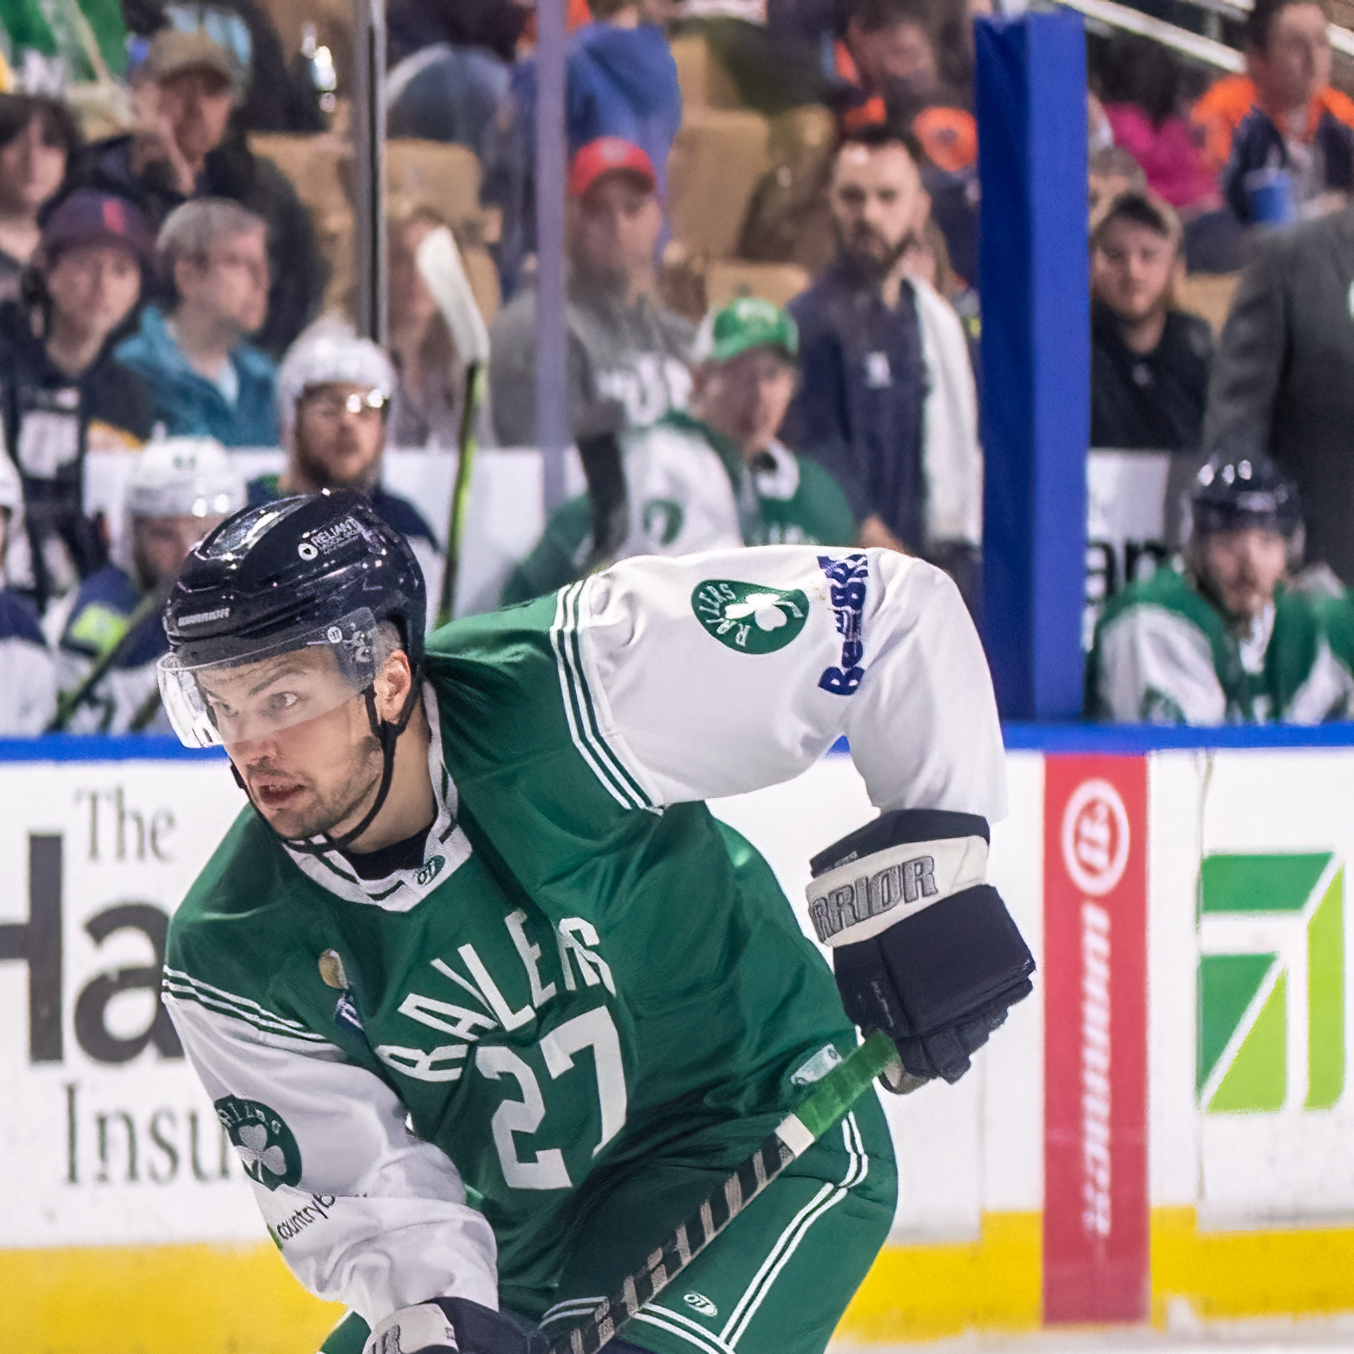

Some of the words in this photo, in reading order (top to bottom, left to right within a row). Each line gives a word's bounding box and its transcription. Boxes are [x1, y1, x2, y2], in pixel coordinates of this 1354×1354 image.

[311, 516, 364, 548] RELIANT
[75, 783, 176, 863] The
[475, 1005, 627, 1190] 27
